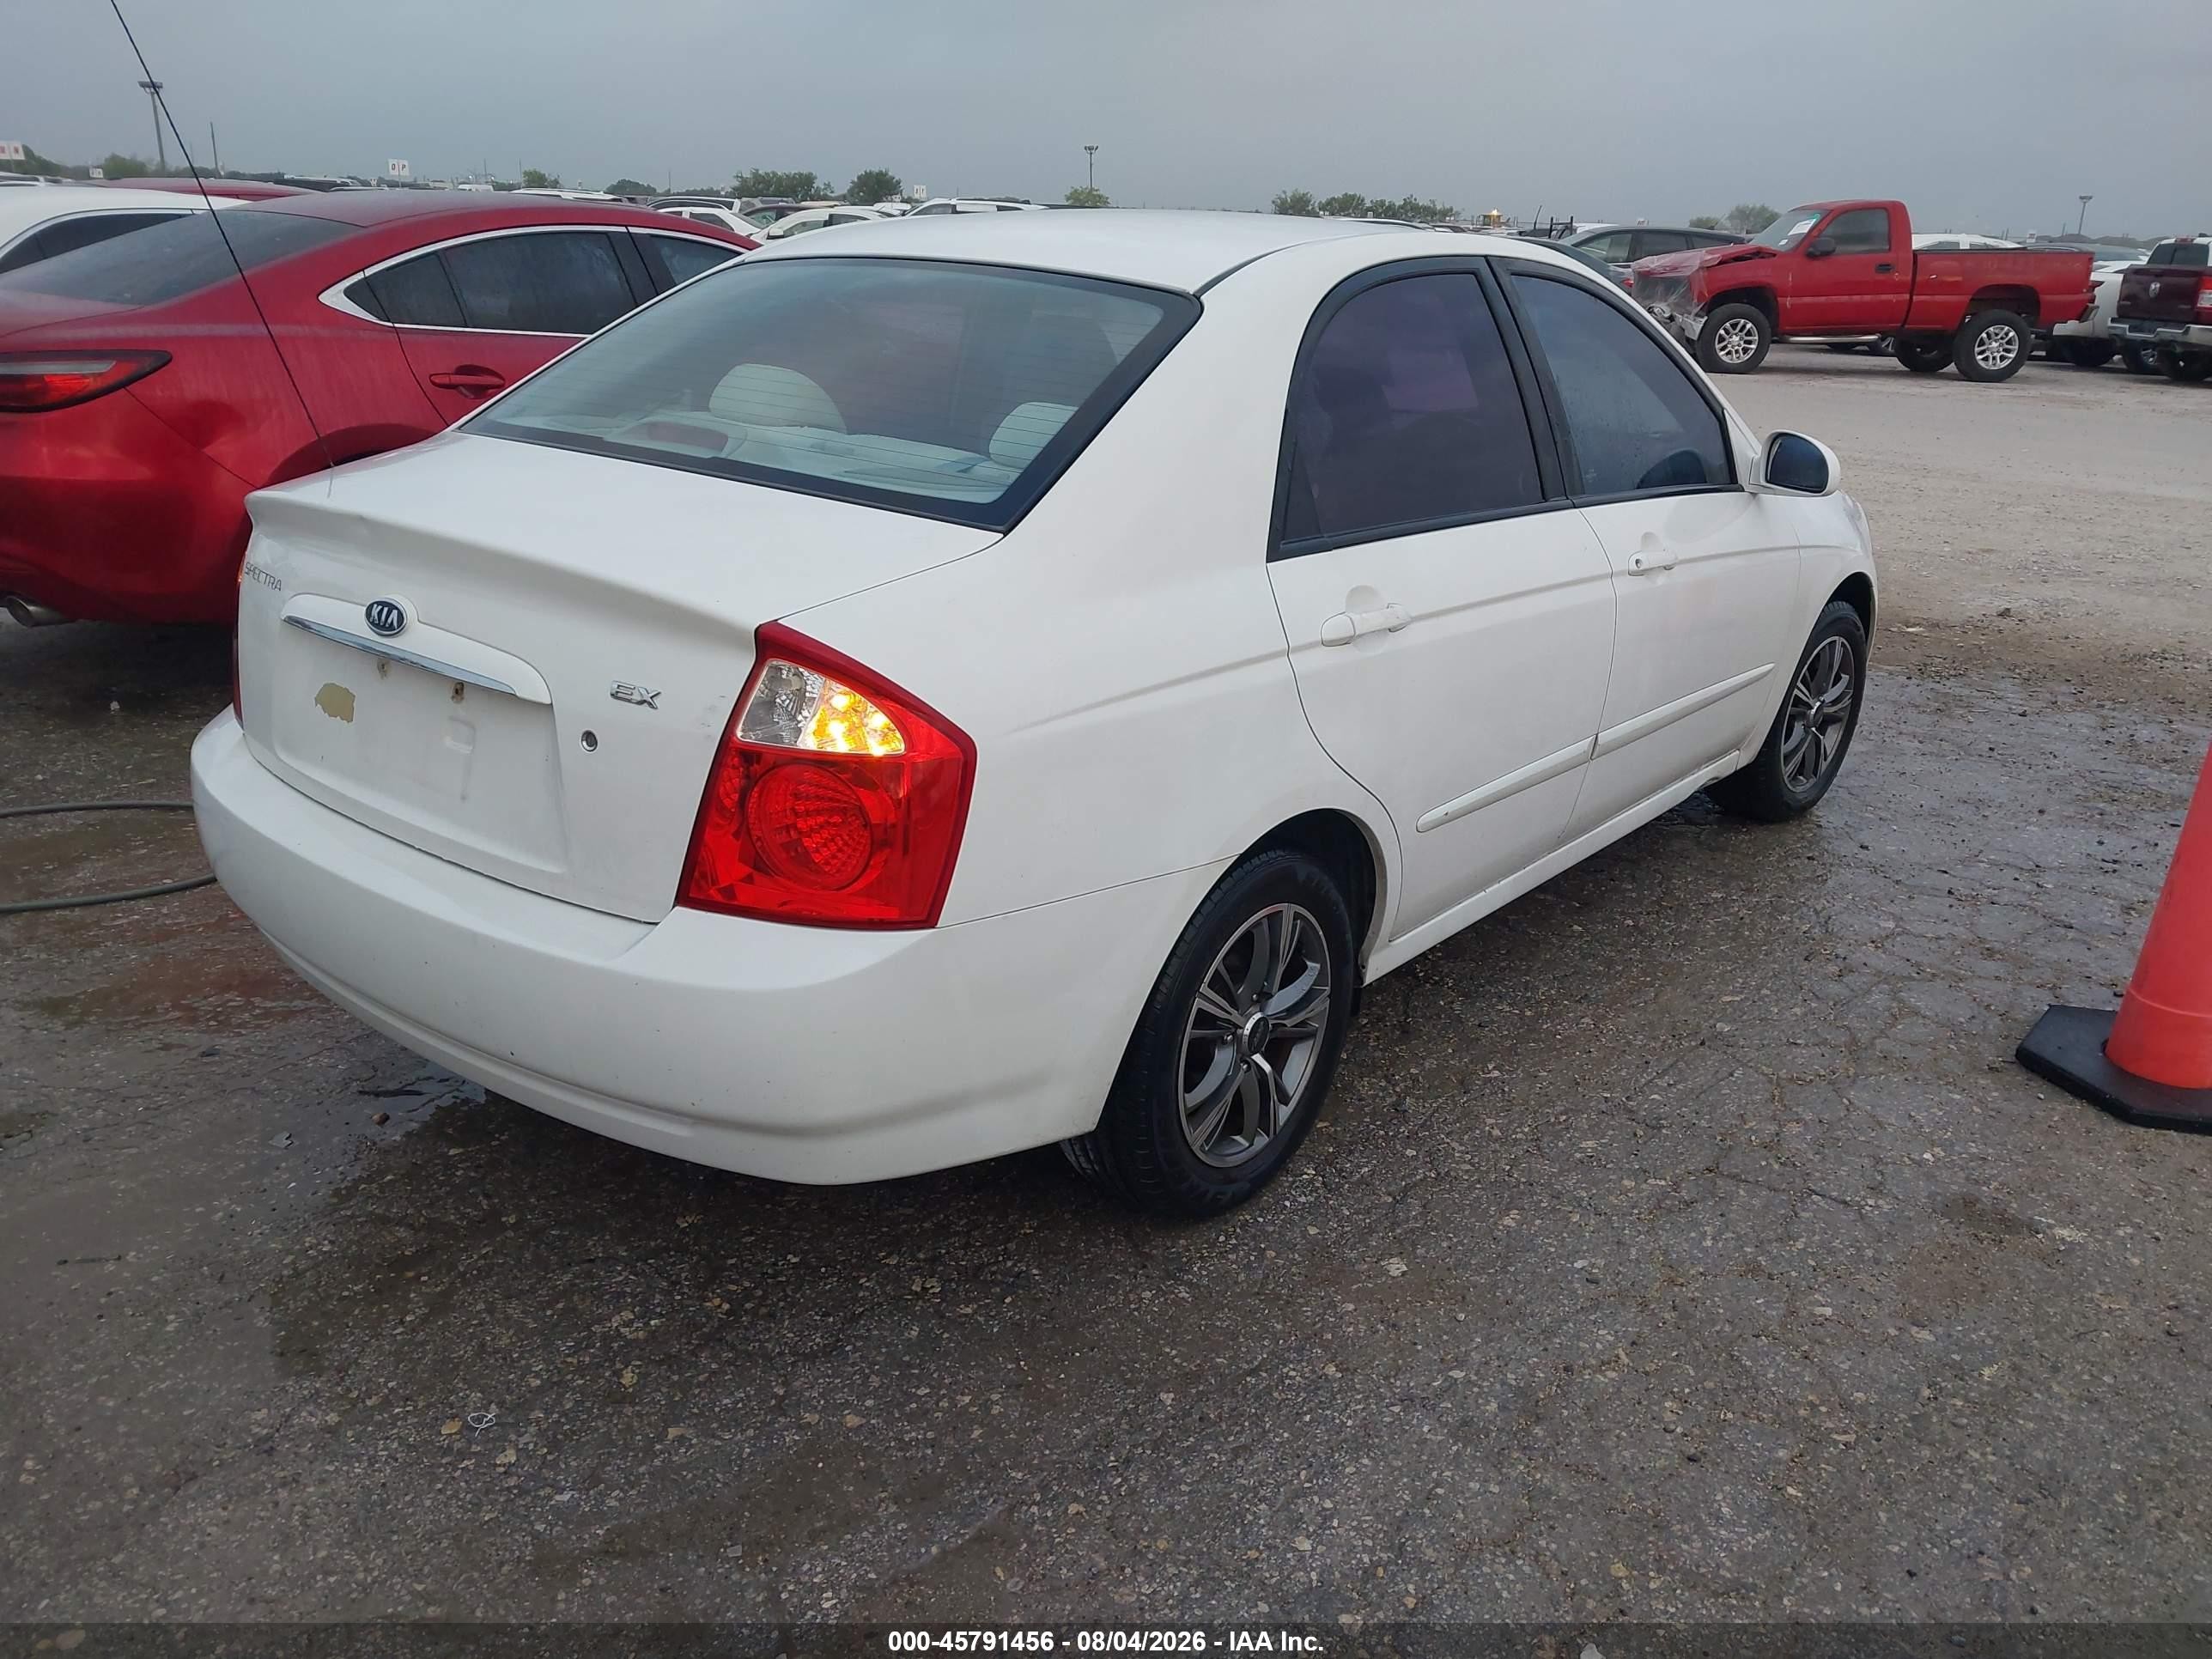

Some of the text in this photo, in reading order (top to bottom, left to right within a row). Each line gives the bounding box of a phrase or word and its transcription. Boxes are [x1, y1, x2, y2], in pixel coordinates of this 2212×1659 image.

[245, 562, 282, 592] SPECTRA
[369, 604, 398, 629] KIA
[610, 680, 662, 709] EX
